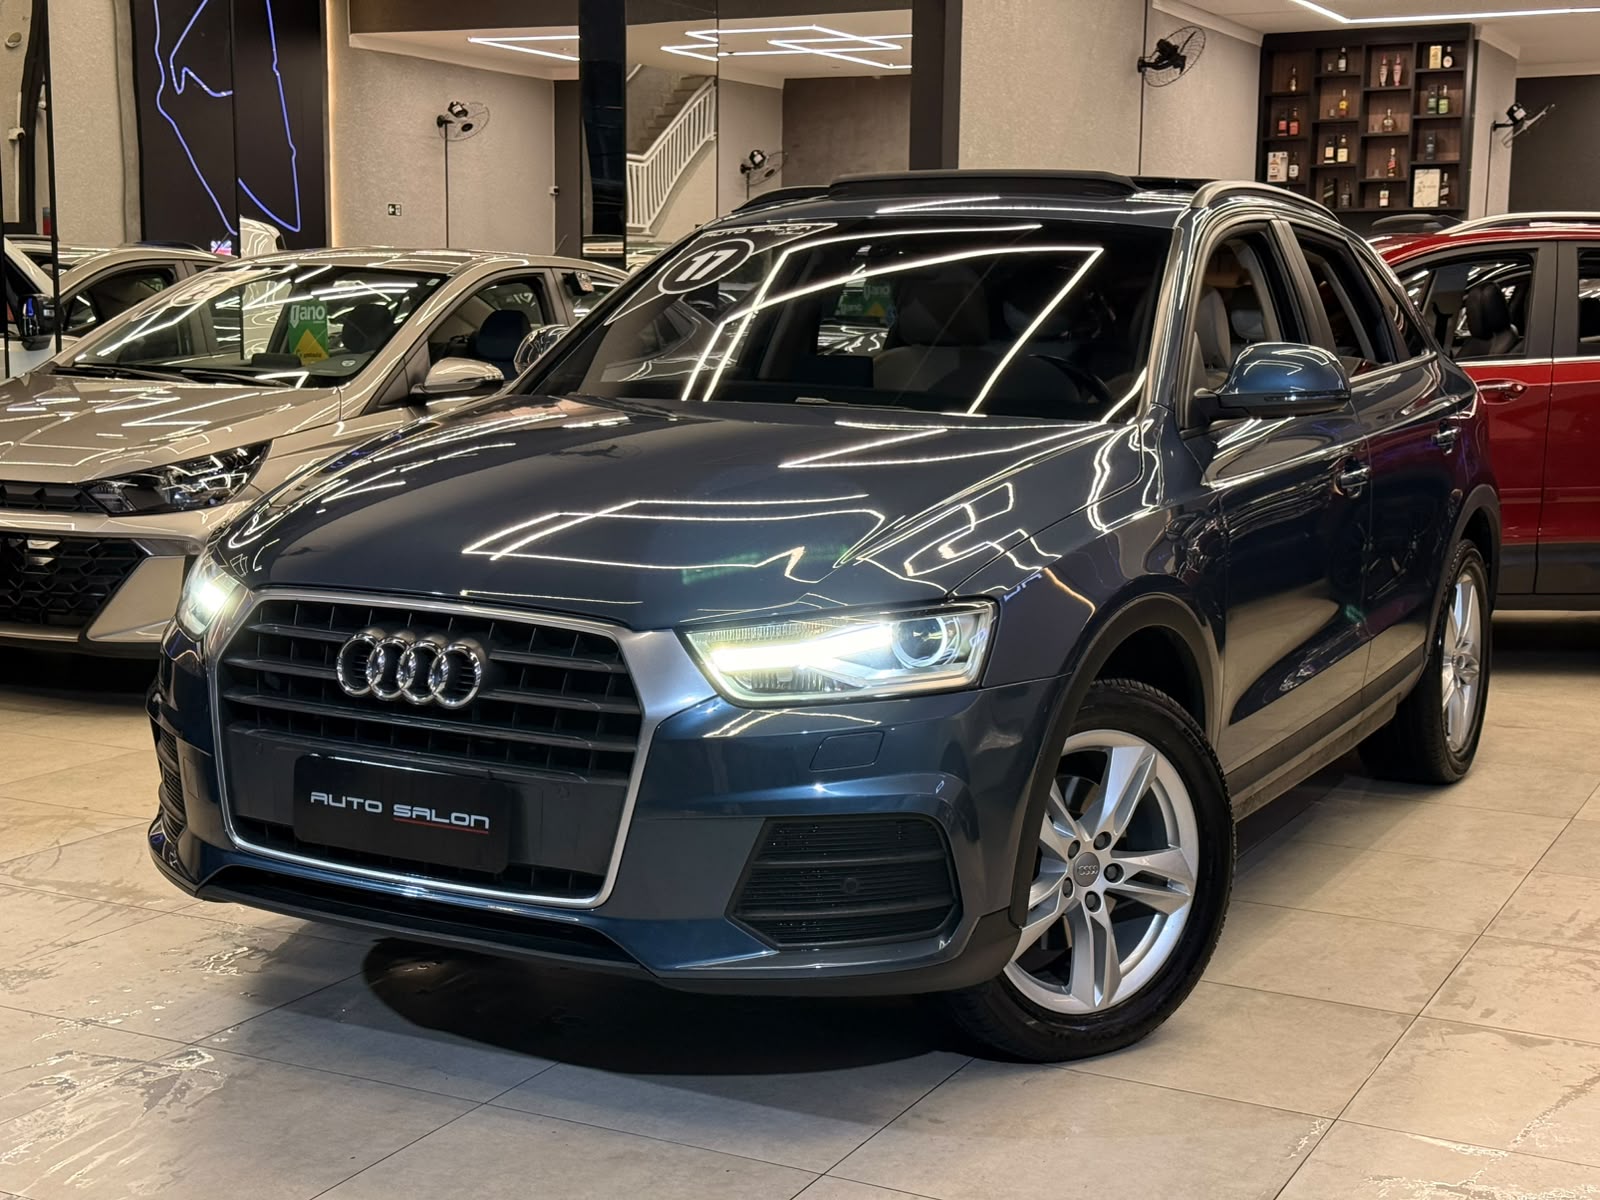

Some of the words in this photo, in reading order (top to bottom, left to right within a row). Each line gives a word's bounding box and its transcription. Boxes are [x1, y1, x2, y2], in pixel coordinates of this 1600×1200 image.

[674, 248, 739, 282] 17
[310, 791, 383, 813] AUTO
[393, 804, 490, 829] SALON
